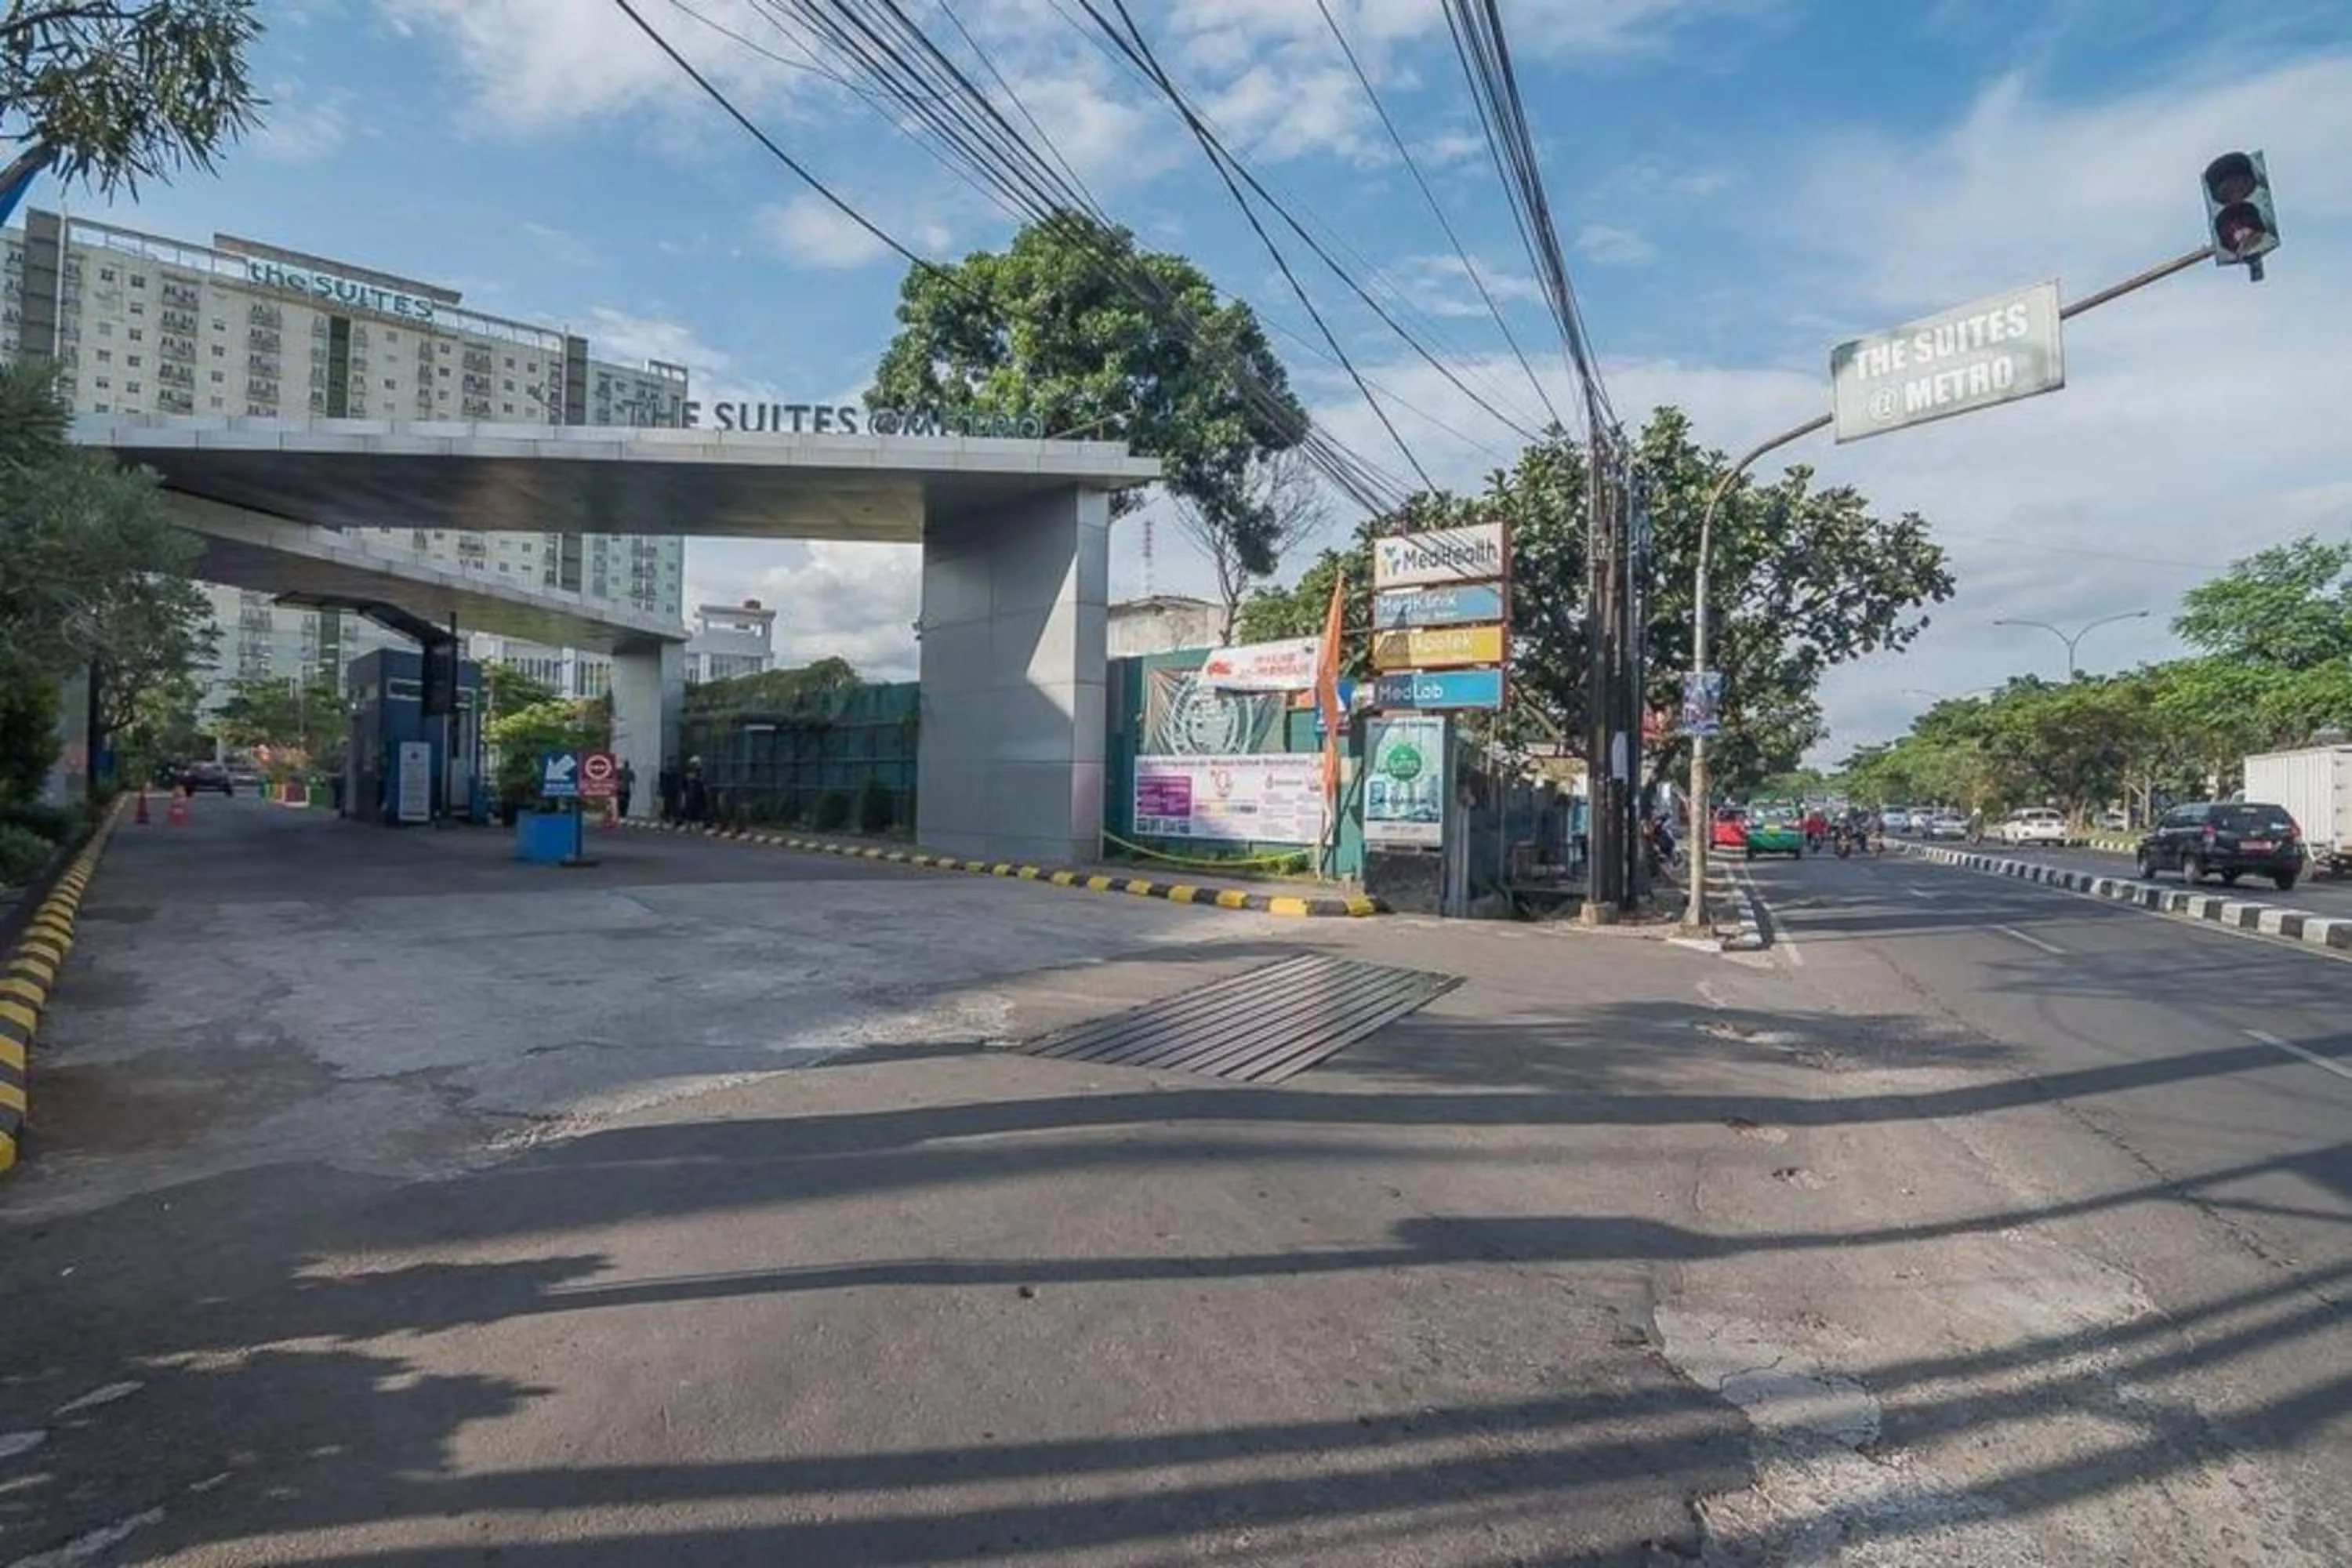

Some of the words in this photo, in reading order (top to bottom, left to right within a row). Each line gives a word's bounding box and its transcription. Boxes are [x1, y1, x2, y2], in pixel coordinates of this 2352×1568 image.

[250, 262, 308, 292] the
[314, 275, 434, 318] SUITES
[1853, 342, 1907, 380] THE
[1913, 303, 2029, 361] SUITES
[1905, 357, 2013, 414] METRO
[626, 399, 700, 429] THE
[714, 401, 858, 435] SUITES
